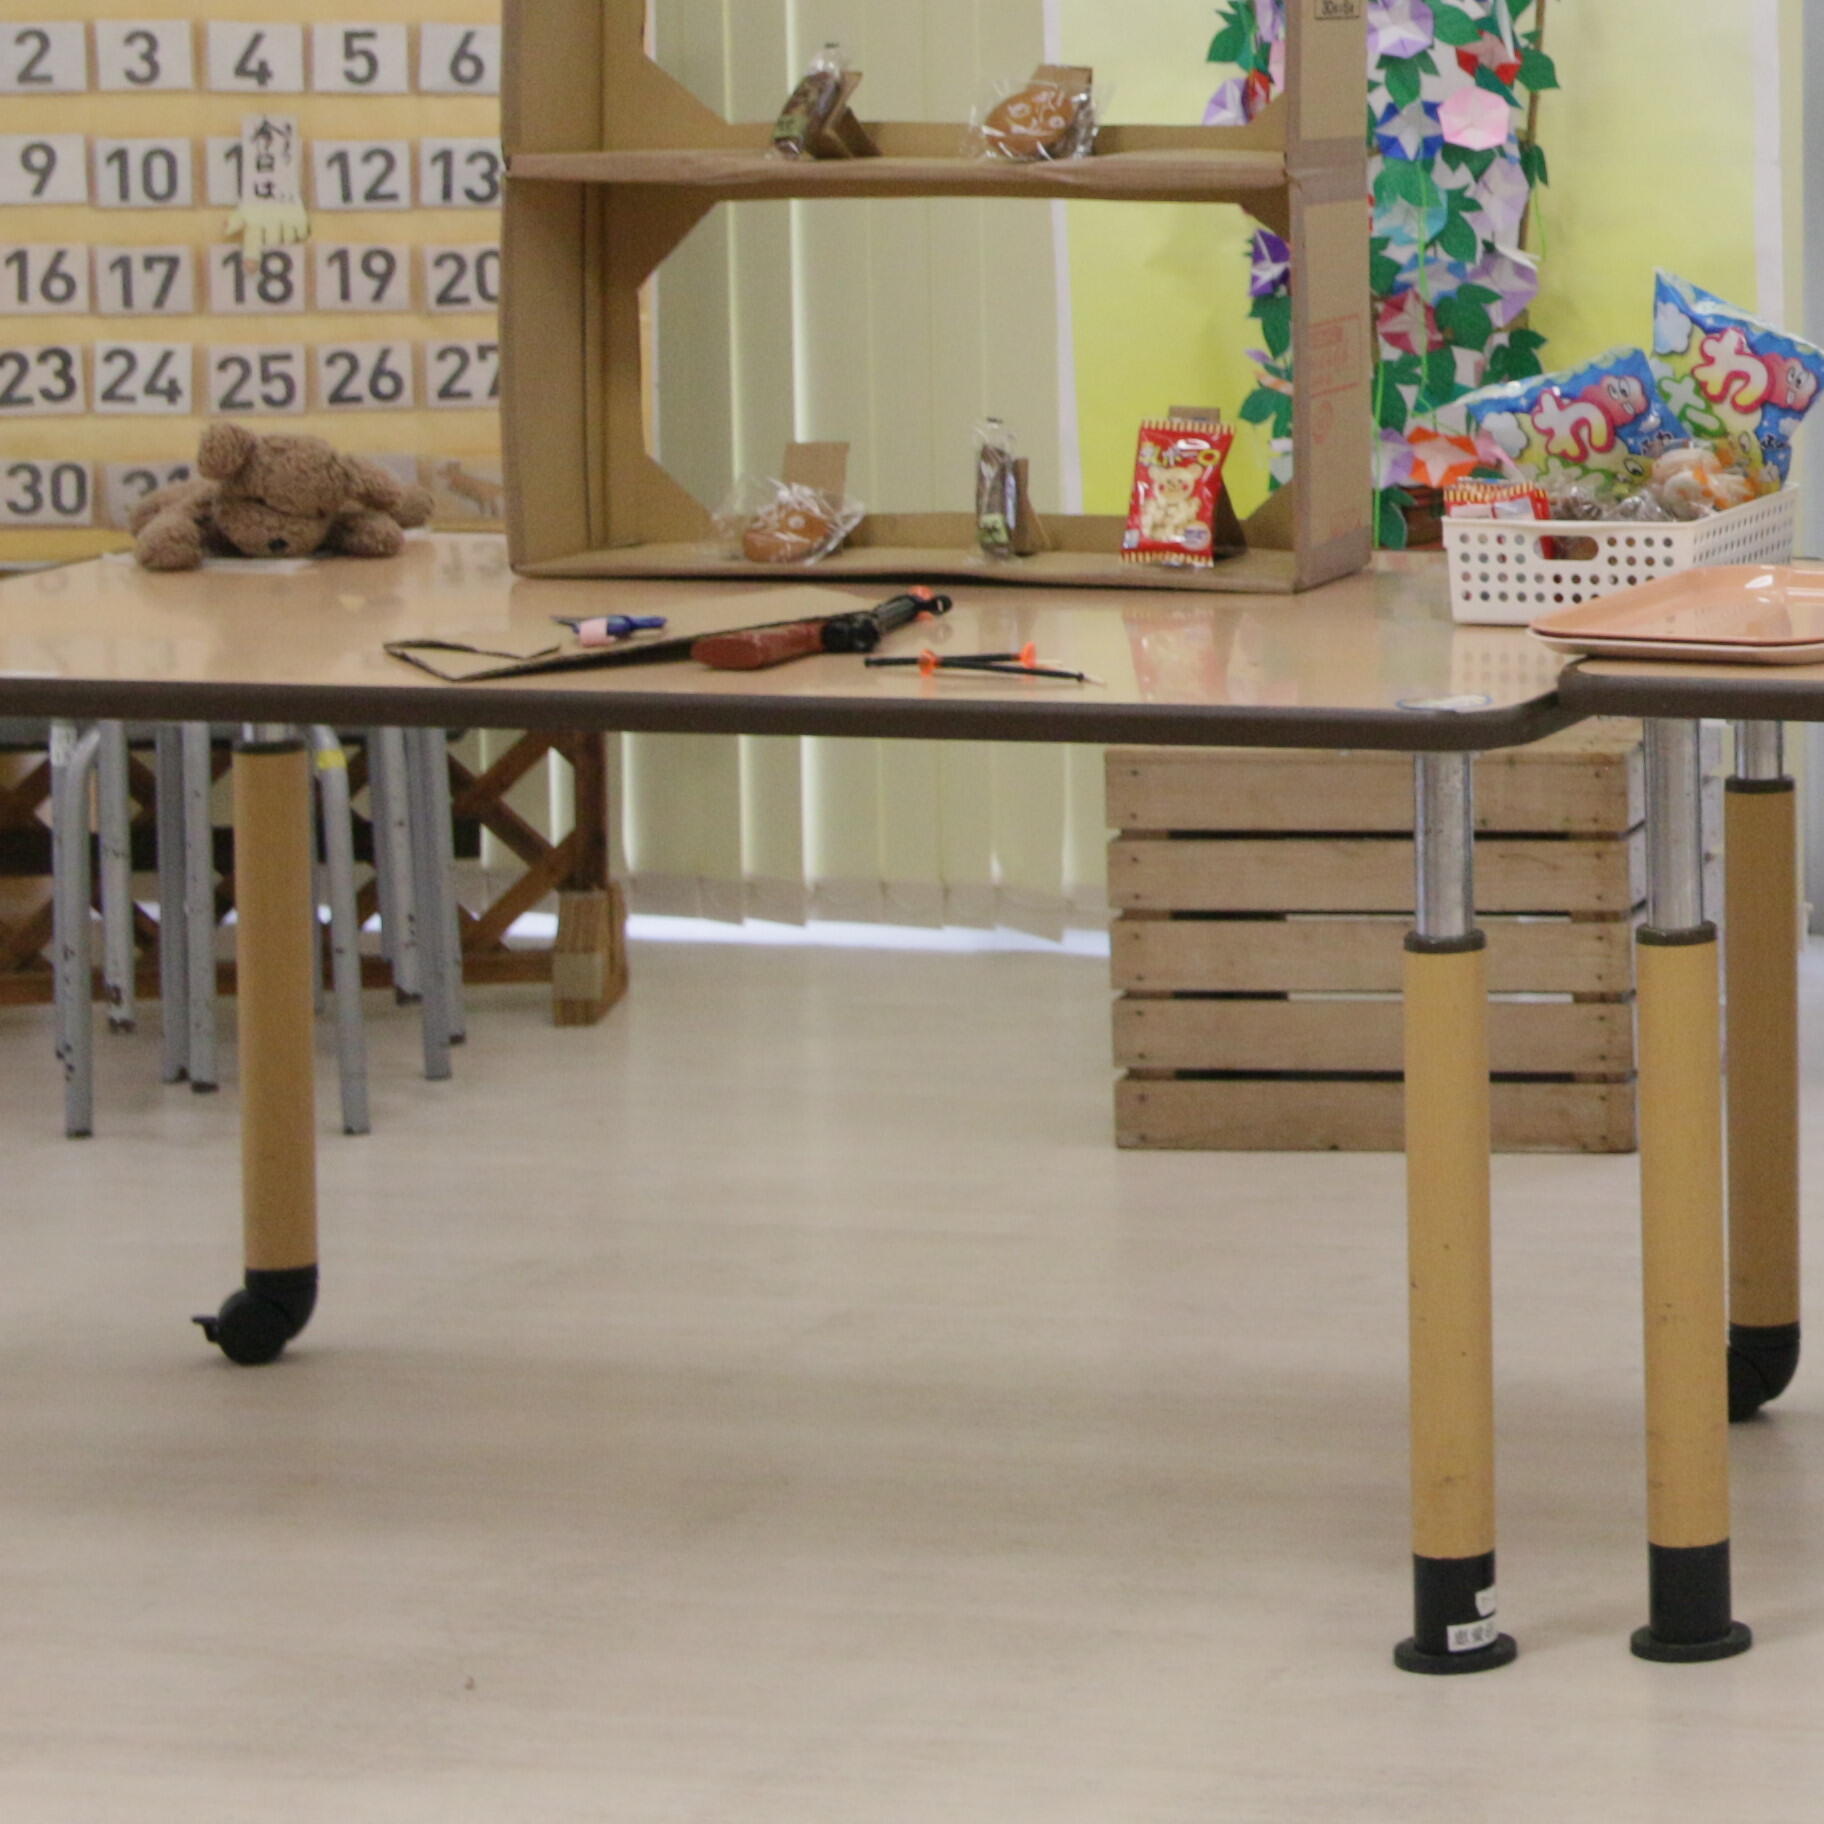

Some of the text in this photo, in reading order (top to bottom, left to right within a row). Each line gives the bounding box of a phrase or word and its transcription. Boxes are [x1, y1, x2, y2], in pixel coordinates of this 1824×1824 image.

[15, 28, 485, 87] 2 3 4 5 6
[20, 141, 498, 206] 9 10 1 12 13
[3, 249, 77, 305] 16
[109, 254, 181, 310] 17
[222, 249, 294, 306] 18
[327, 248, 397, 303] 19
[0, 346, 77, 408] 23
[100, 347, 183, 405] 24
[216, 353, 296, 412] 25
[325, 348, 404, 407] 26
[6, 462, 88, 517] 30
